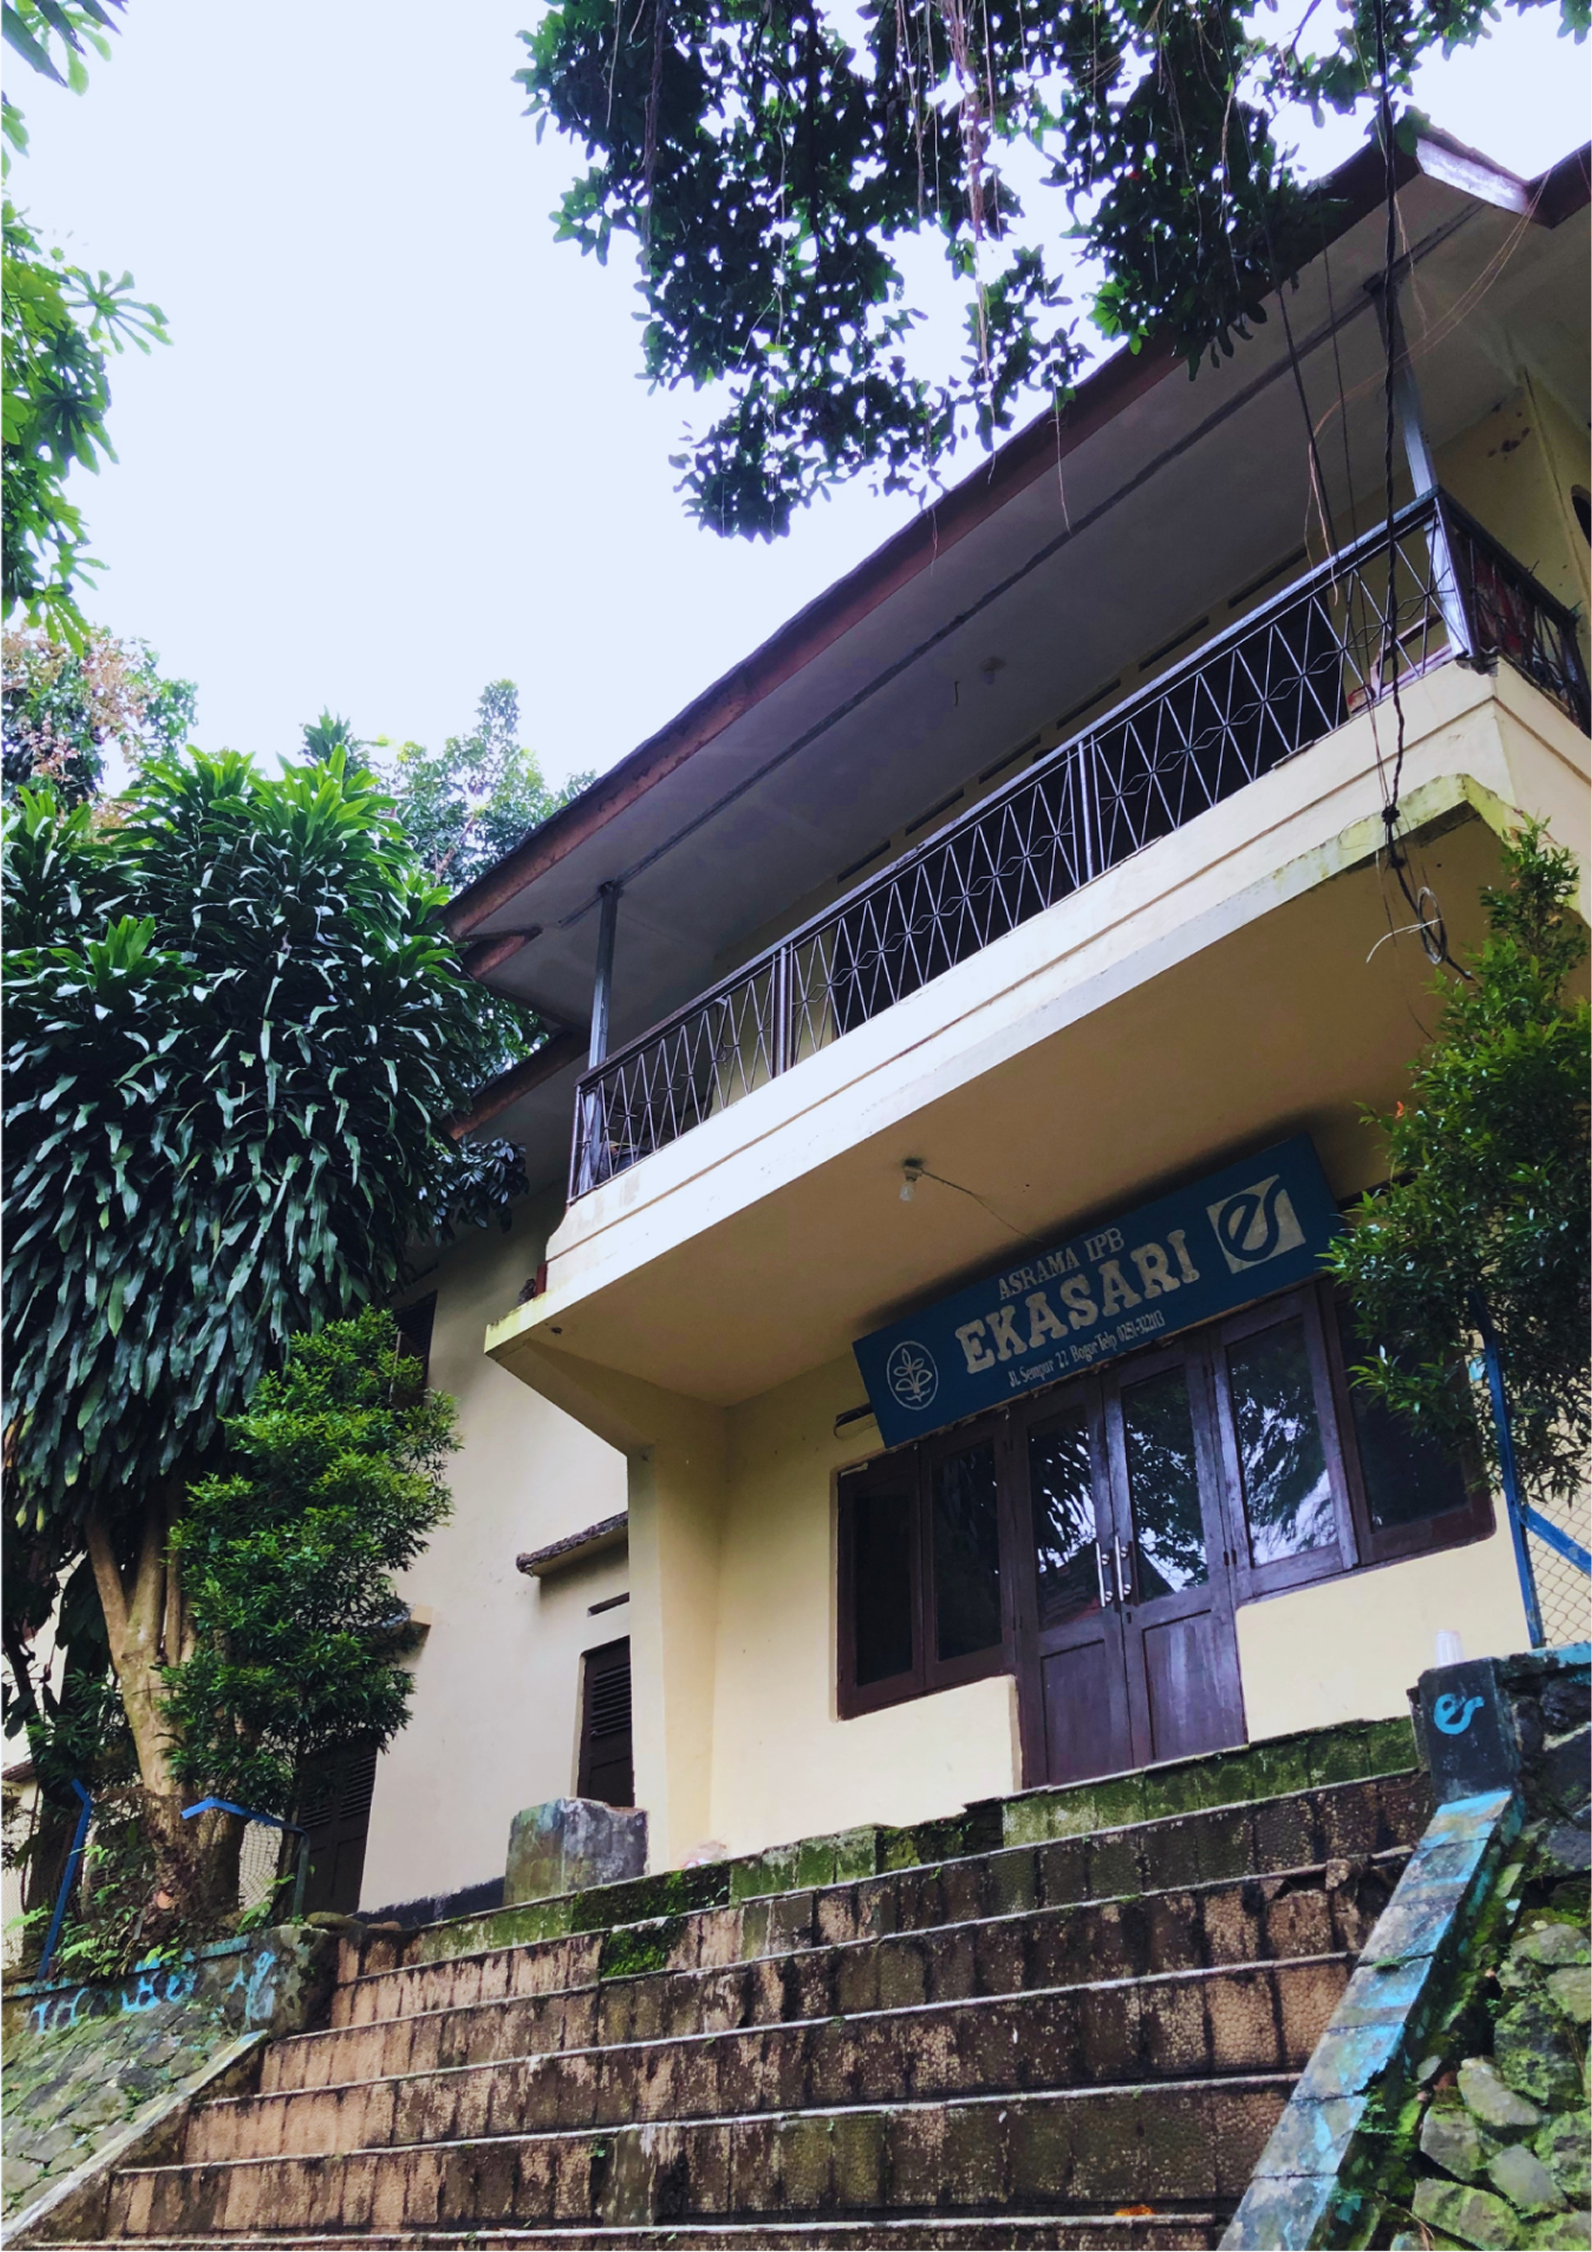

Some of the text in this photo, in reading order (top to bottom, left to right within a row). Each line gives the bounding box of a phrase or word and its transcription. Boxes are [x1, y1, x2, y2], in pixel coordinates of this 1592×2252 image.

[998, 1227, 1125, 1300] ASRAMA IPB
[954, 1229, 1200, 1375] EKASARI
[1069, 1341, 1098, 1363] Bogor
[1095, 1331, 1118, 1352] Telp
